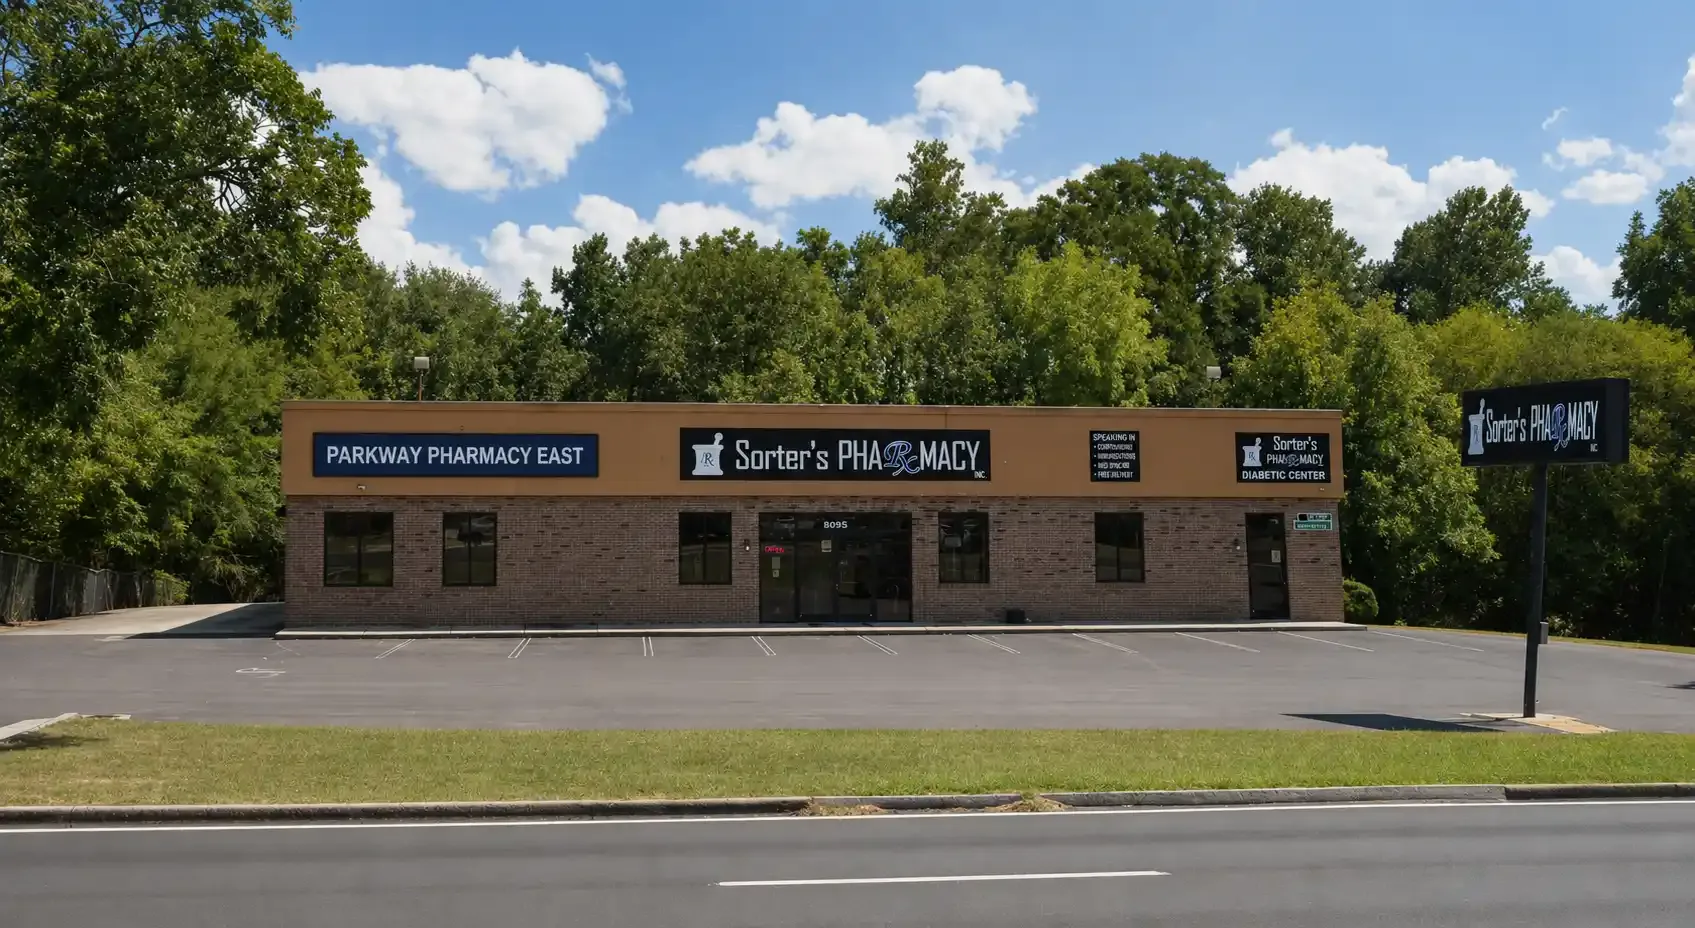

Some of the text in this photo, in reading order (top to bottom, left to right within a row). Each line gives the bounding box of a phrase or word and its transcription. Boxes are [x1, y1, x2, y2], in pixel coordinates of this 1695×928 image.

[1486, 406, 1527, 443] Sorter's
[1273, 435, 1318, 451] Sorter's
[326, 445, 584, 465] PARKWAY PHARMACY EAST
[735, 439, 829, 471] Sorter's
[1242, 470, 1326, 480] DIABETIC CENTER
